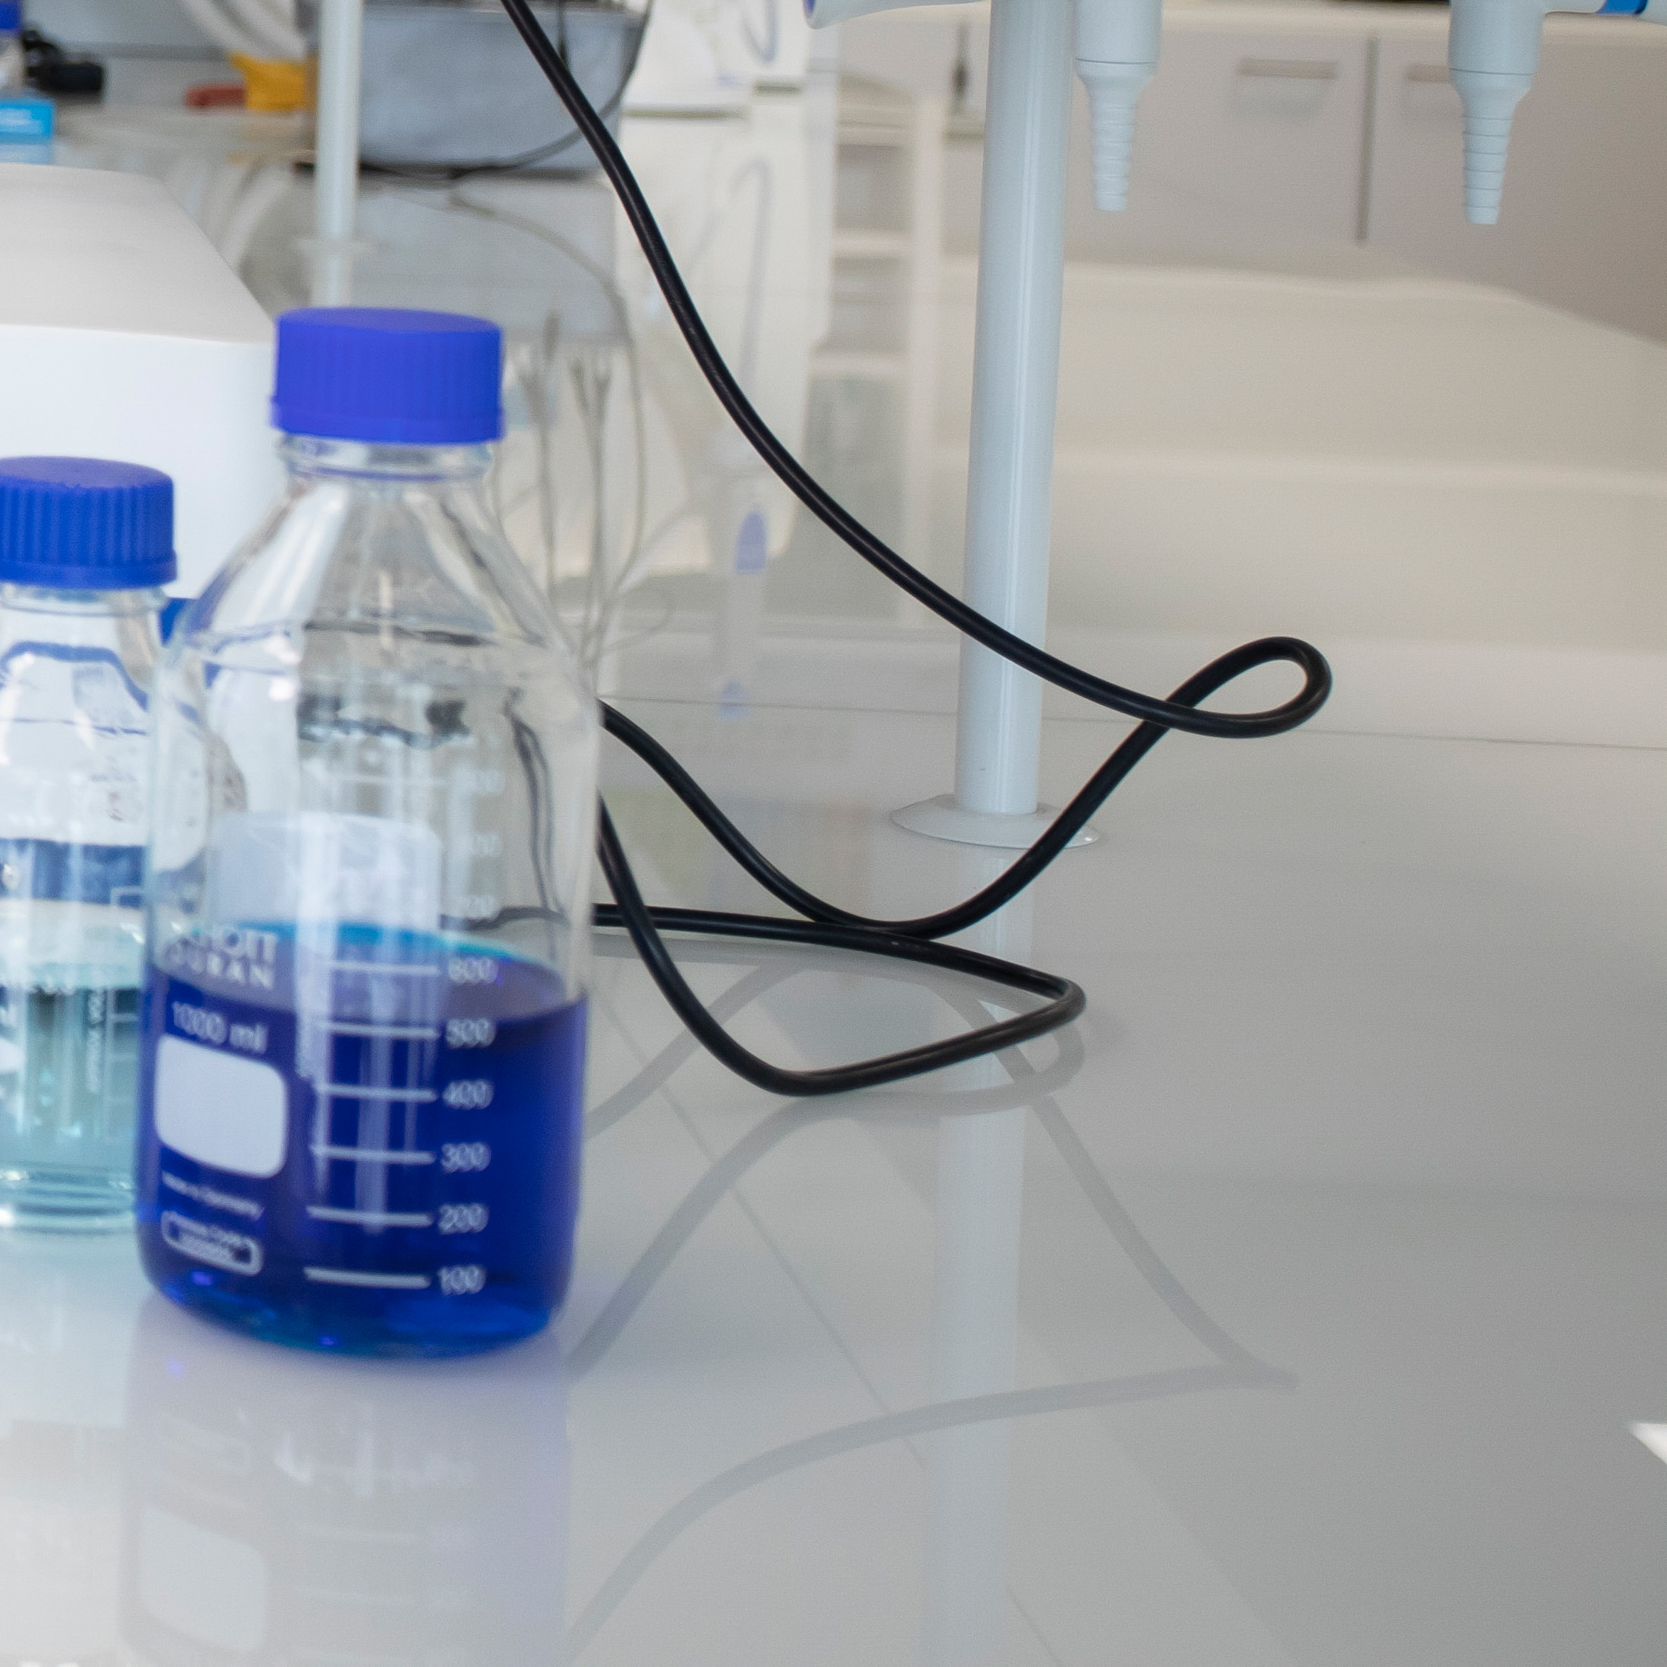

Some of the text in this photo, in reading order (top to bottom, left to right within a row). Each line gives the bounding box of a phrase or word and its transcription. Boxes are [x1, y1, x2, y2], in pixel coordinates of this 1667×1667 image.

[171, 1001, 267, 1053] 1000 ml
[446, 1018, 496, 1048] 500
[442, 1080, 494, 1109] 400
[440, 1143, 491, 1173] 300
[438, 1203, 488, 1234] 200
[437, 1264, 486, 1295] 100
